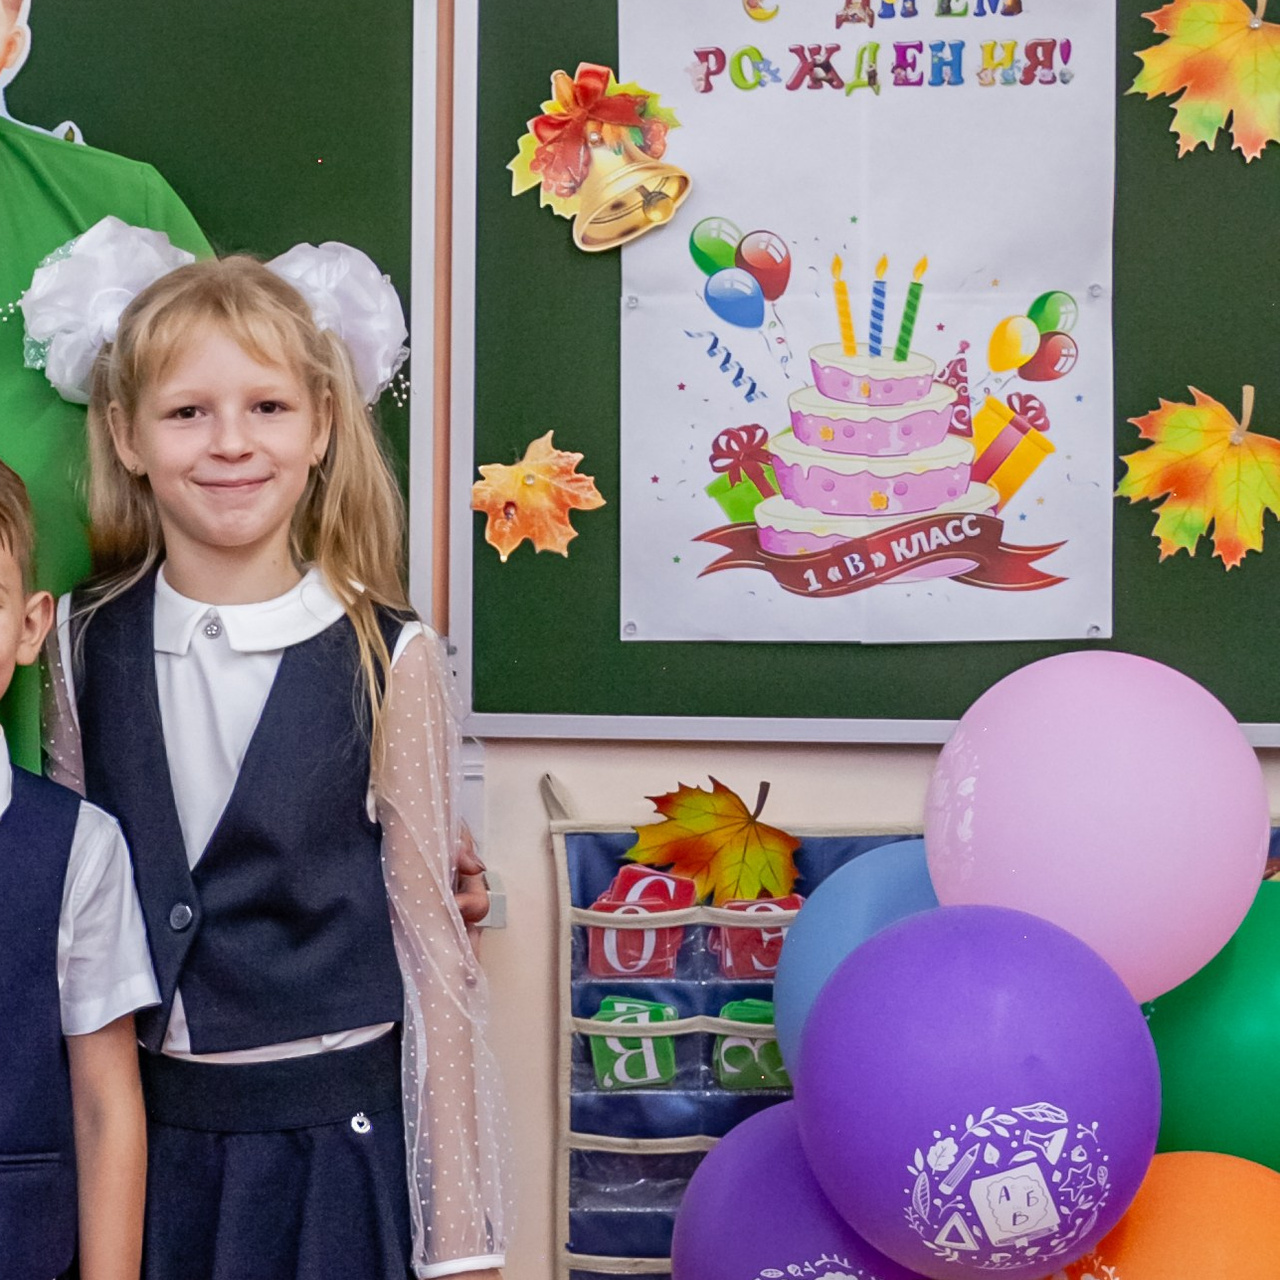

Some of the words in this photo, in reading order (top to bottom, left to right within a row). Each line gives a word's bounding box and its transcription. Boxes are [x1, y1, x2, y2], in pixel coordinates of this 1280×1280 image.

[691, 36, 1076, 99] РОЖДЕНИЯ!
[802, 567, 823, 593] 1
[889, 513, 982, 564] КЛАСС
